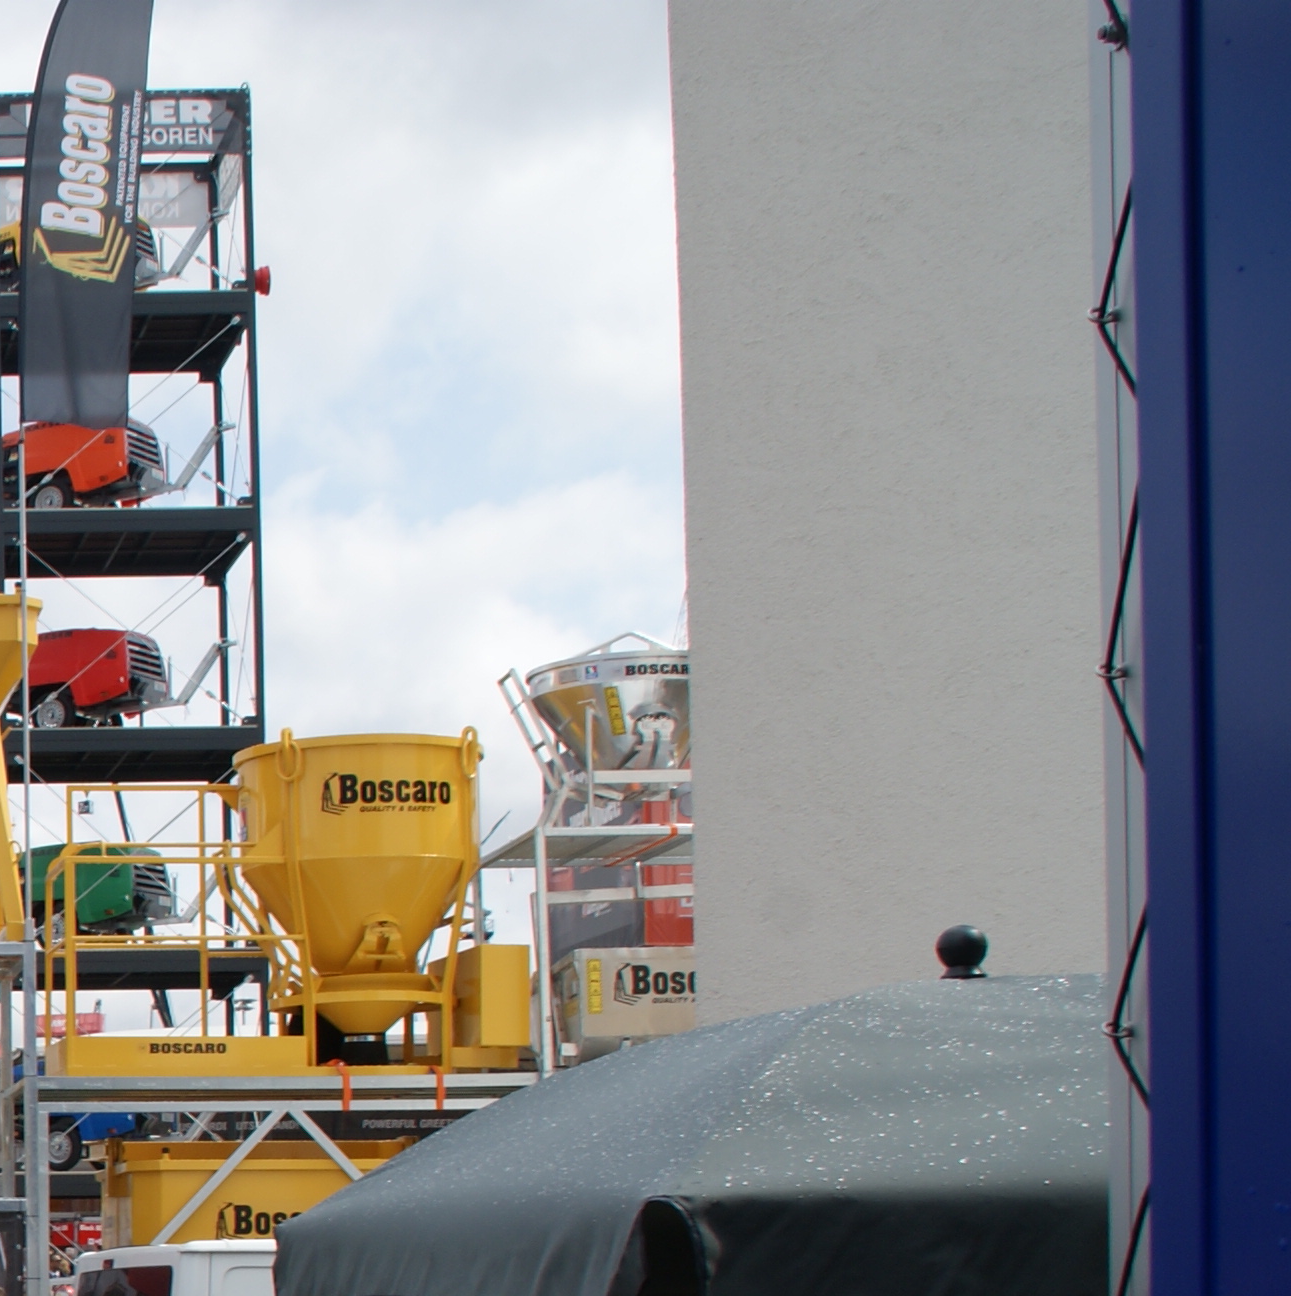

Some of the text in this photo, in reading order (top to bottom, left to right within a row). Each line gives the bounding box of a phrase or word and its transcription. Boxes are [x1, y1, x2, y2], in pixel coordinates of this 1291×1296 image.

[40, 73, 115, 238] Boscaro
[116, 104, 130, 206] PATENTED EQUIPMENT
[128, 138, 139, 182] BUILDING
[126, 184, 135, 202] THE
[124, 204, 133, 223] FOR
[339, 774, 451, 804] Boscaro
[149, 1043, 227, 1054] BOSCARO
[362, 1119, 417, 1129] POWERFUL
[234, 1205, 302, 1235] Bos
